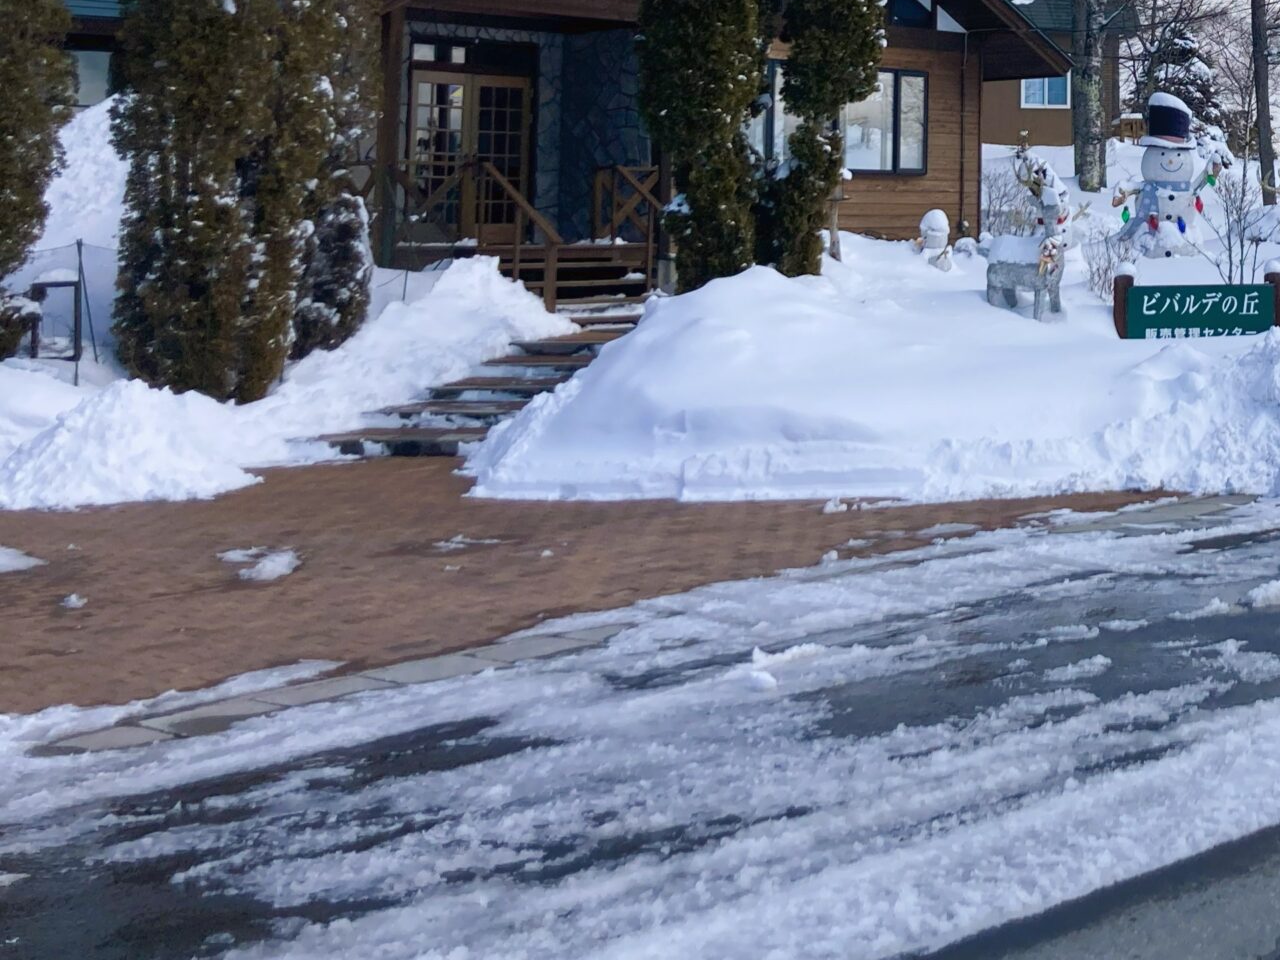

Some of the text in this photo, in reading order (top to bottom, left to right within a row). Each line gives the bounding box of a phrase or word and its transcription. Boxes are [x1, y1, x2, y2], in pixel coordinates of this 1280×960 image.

[1142, 291, 1259, 315] ビバルデの丘
